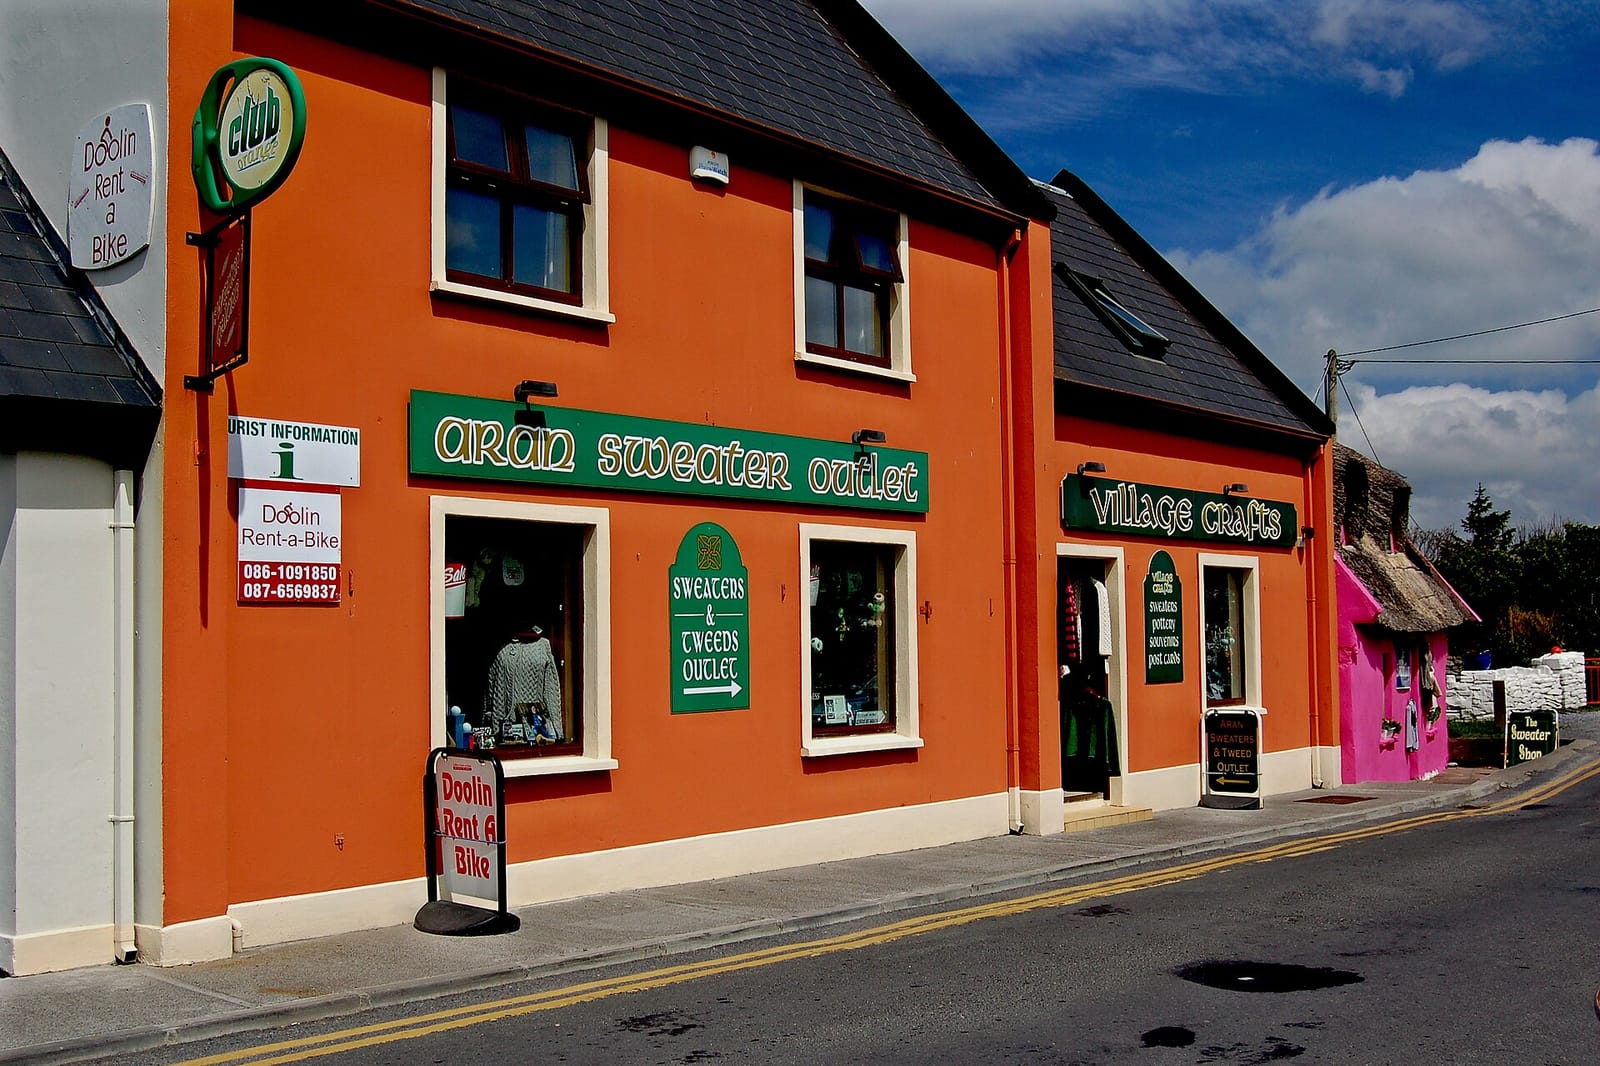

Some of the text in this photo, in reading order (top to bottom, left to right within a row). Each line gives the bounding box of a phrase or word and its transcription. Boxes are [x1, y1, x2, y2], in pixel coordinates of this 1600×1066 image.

[228, 86, 281, 157] club
[84, 128, 136, 172] Doolin
[95, 166, 125, 201] Rent
[105, 202, 115, 225] a
[92, 233, 127, 264] Bike
[271, 423, 358, 446] INFORMATION
[262, 503, 320, 526] Doolin
[242, 528, 339, 549] Rent-a-Bike
[243, 563, 337, 581] 086-1091850
[243, 583, 337, 599] 087-6569837
[673, 576, 745, 600] SWEATERS
[705, 603, 716, 626] &
[681, 630, 739, 654] TWEEDS
[683, 657, 738, 681] OUTLET
[1511, 724, 1551, 741] Sweater
[1524, 716, 1538, 727] The
[1213, 748, 1220, 757] &
[442, 772, 493, 807] Doolin
[443, 808, 496, 844] Rent A
[454, 845, 490, 880] Bike
